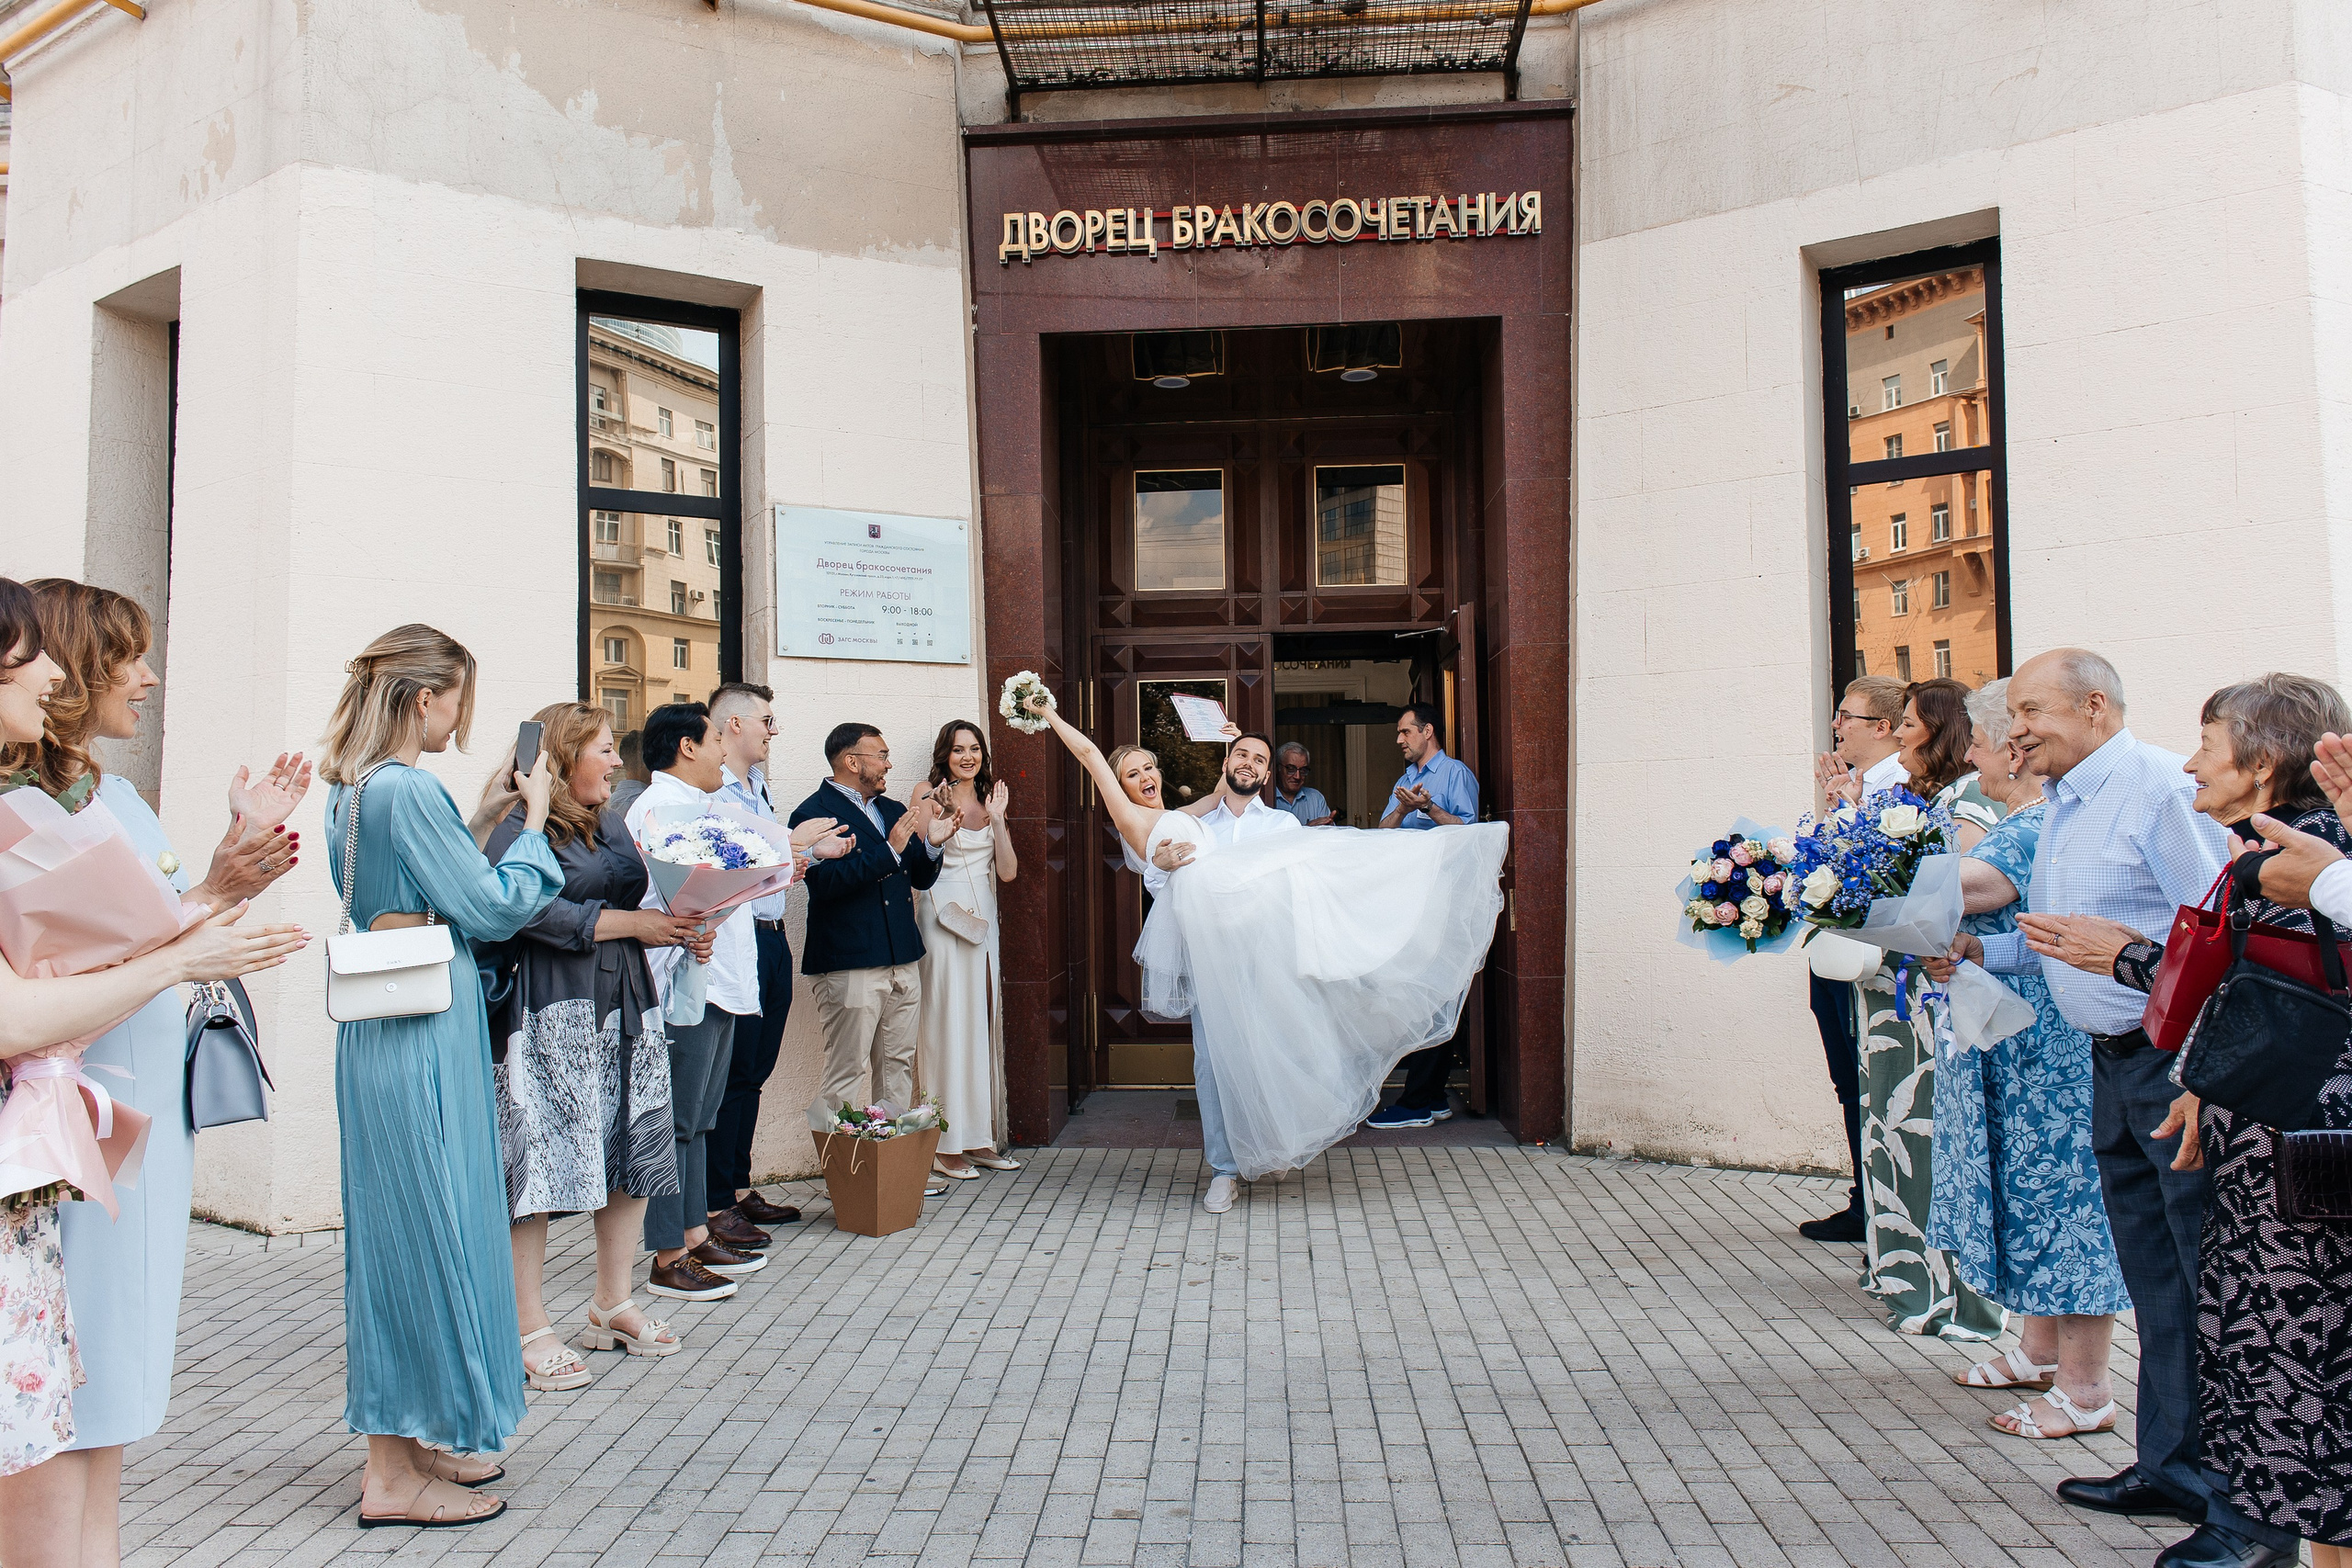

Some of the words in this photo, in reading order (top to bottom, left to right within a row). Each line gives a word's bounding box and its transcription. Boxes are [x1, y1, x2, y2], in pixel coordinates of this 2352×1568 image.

[999, 208, 1158, 265] ДВОРЕЦ
[1172, 190, 1542, 249] БРАКОСОЧЕТАНИЯ
[817, 558, 854, 570] Дворец
[856, 560, 933, 575] бракосочетания
[840, 588, 874, 599] РЕЖИМ
[876, 591, 911, 601] РАБОТЫ
[881, 604, 901, 615] 9:00
[910, 606, 933, 616] 18:00
